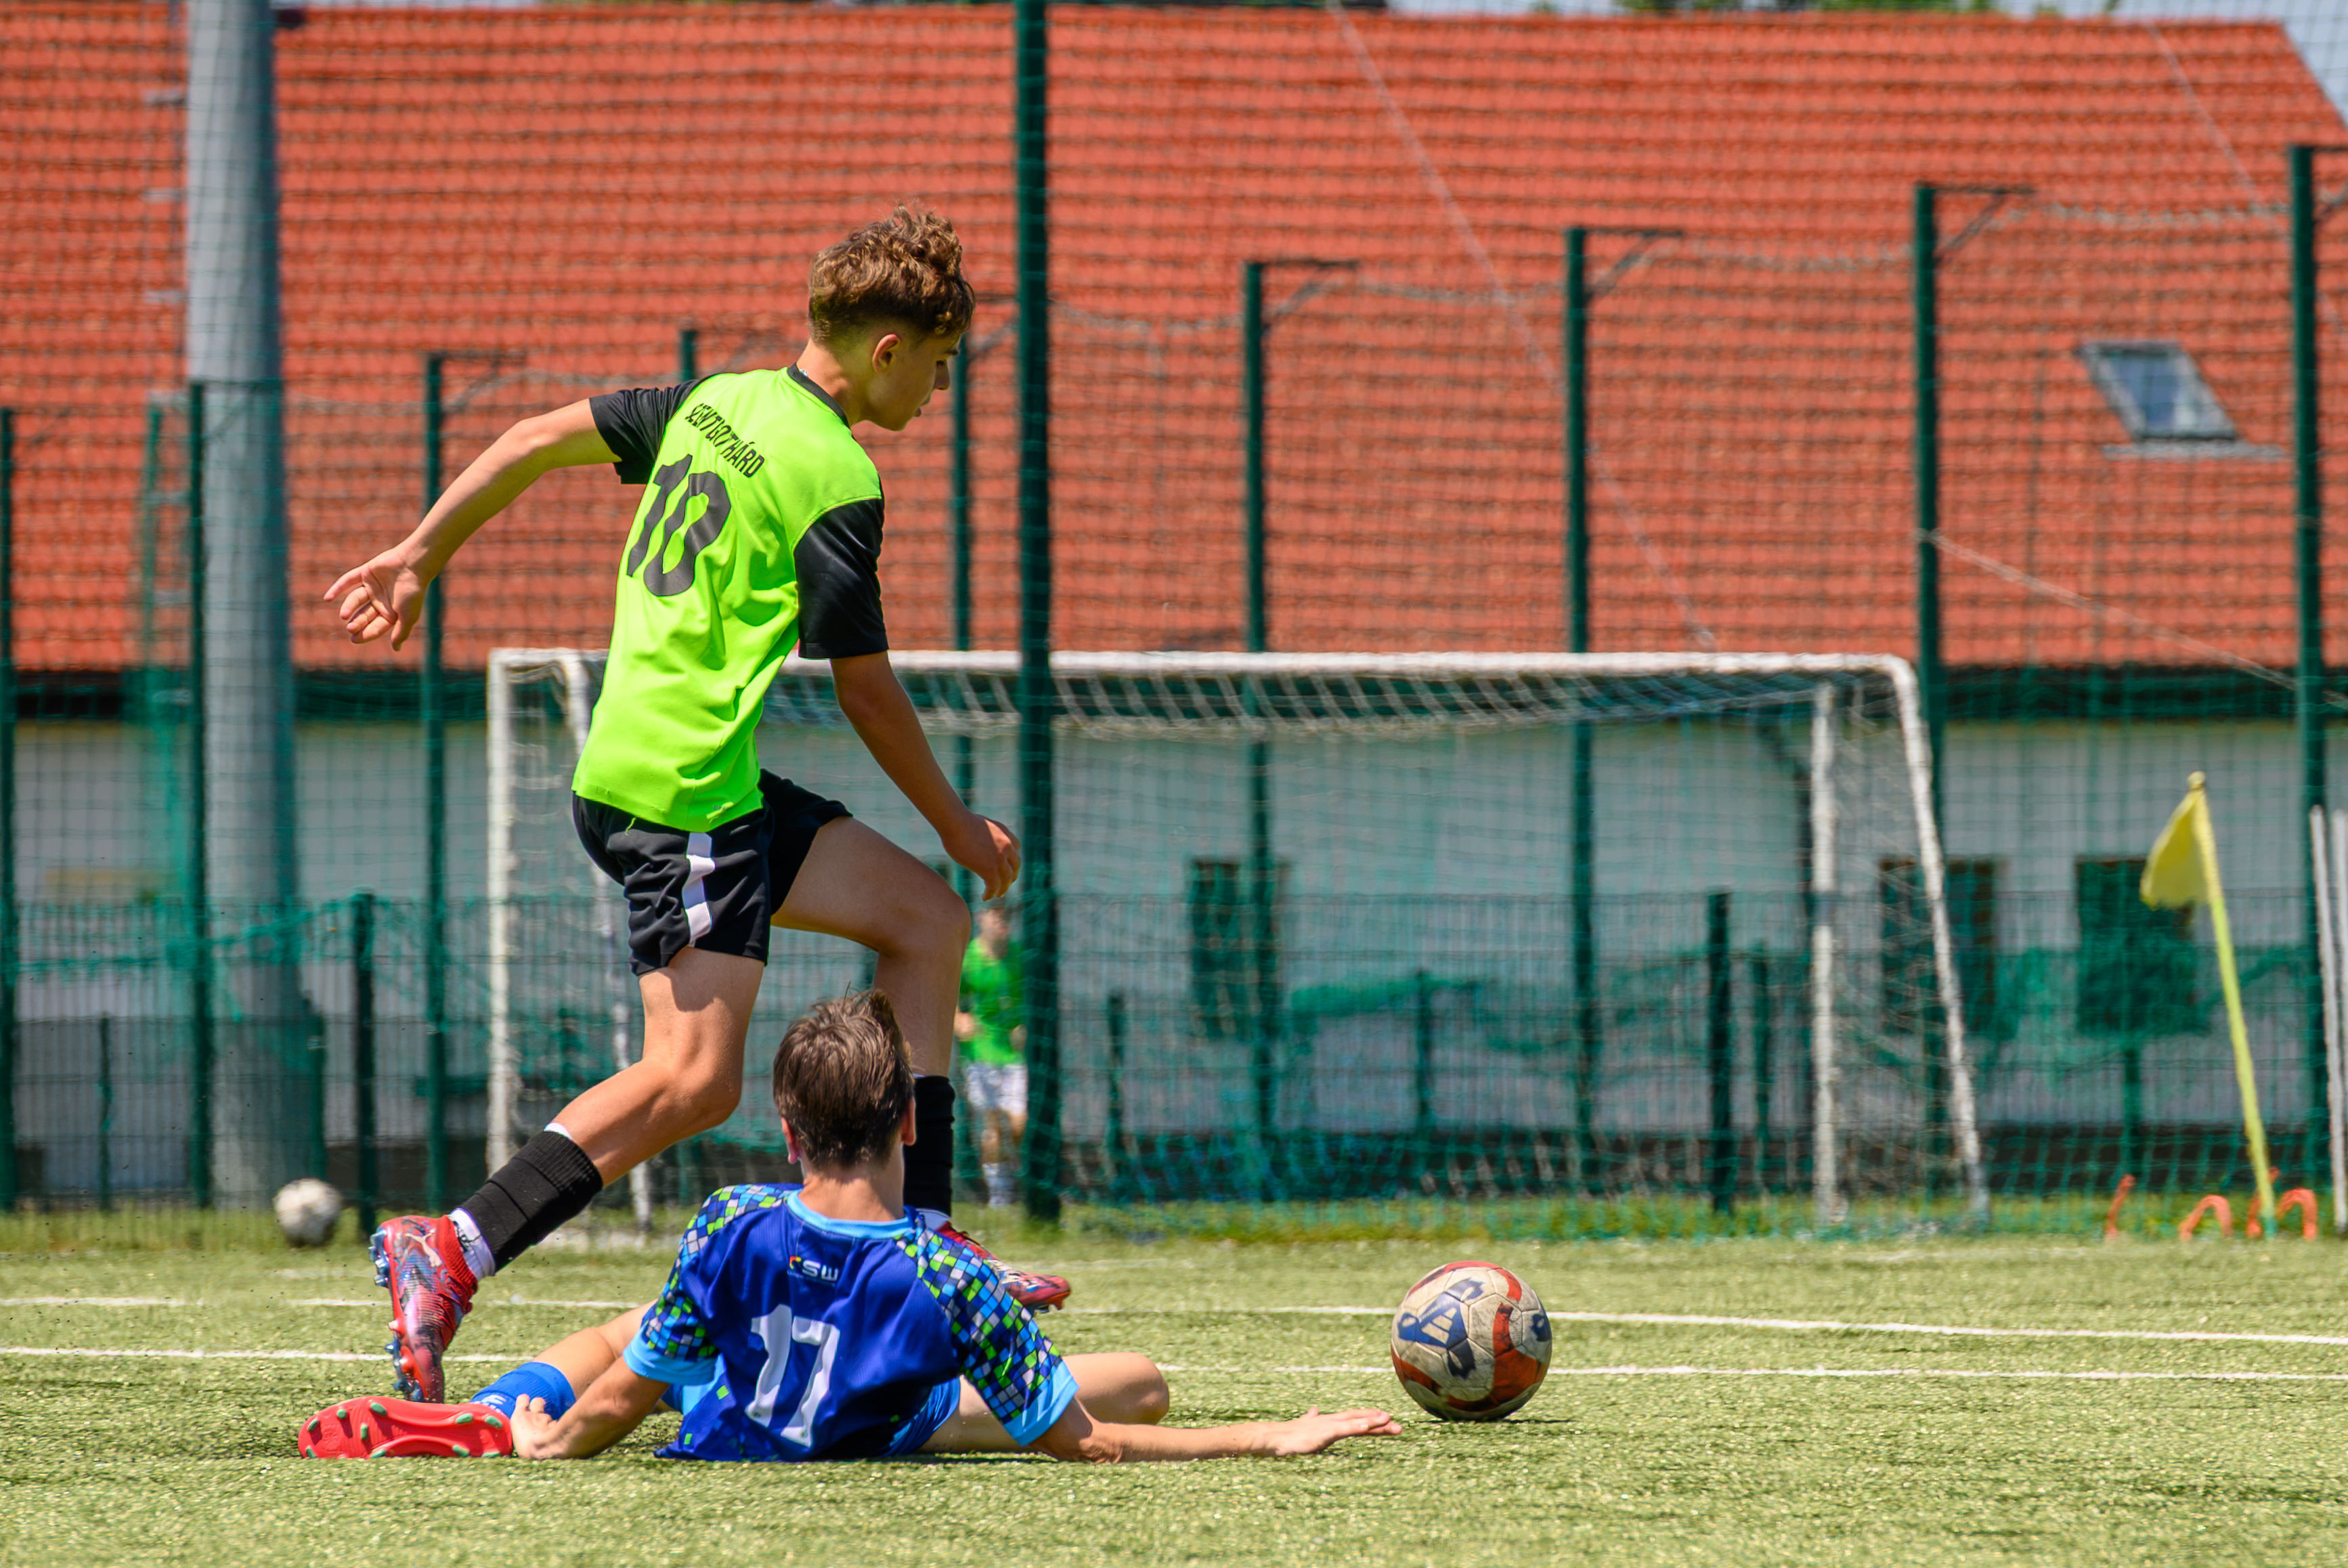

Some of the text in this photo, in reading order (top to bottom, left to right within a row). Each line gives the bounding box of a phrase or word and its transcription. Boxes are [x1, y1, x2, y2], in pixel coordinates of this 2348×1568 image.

[684, 403, 765, 478] SZENTGOTHÁRD
[626, 454, 731, 596] 10
[745, 1304, 840, 1447] 17
